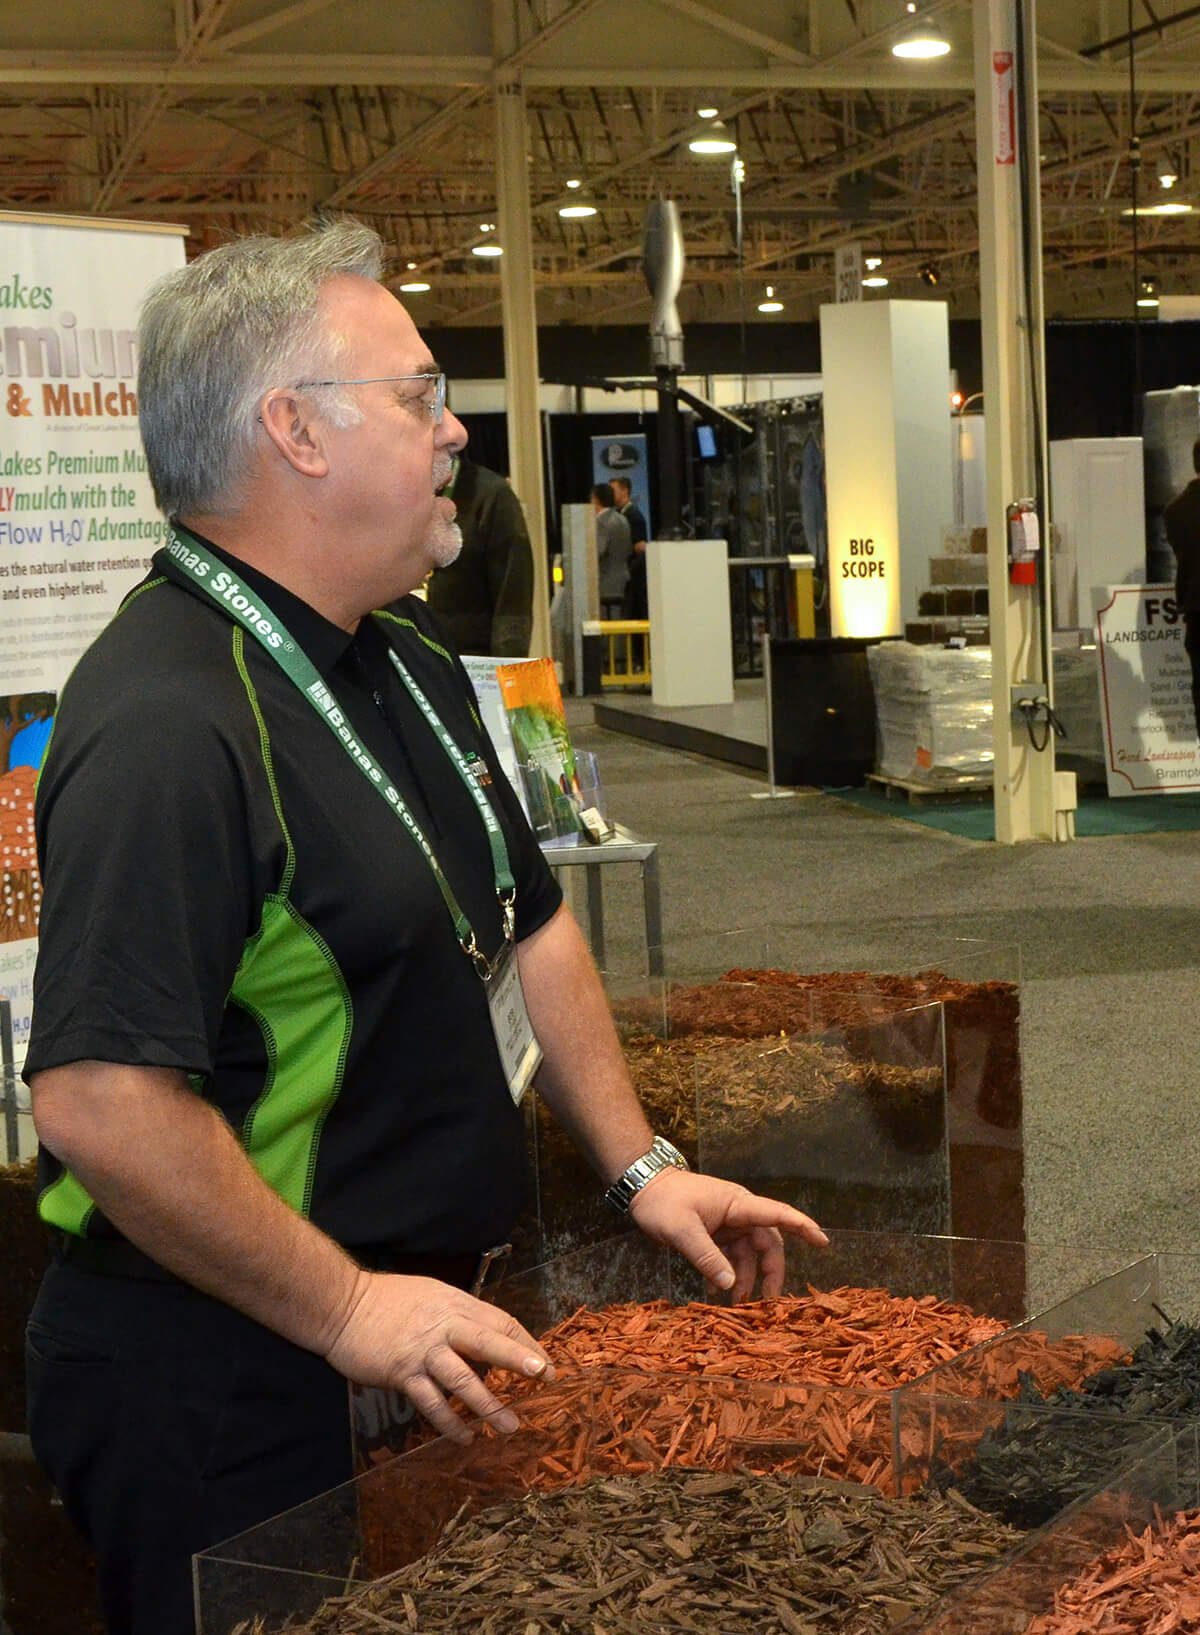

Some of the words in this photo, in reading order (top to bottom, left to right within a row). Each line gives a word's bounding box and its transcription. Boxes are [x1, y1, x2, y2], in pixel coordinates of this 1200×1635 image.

[6, 382, 33, 417] &
[42, 382, 138, 417] Mulch
[47, 450, 119, 474] Premium
[70, 483, 107, 509] with
[111, 483, 136, 507] the
[166, 529, 210, 577] Banas
[849, 538, 875, 556] BIG
[11, 562, 27, 576] the
[30, 560, 67, 575] natural
[69, 559, 96, 573] water
[97, 556, 141, 570] retention
[842, 561, 885, 578] SCOPE
[3, 586, 19, 600] and
[22, 588, 46, 599] even
[50, 583, 80, 600] higher
[1106, 628, 1182, 643] LANDSCAPE
[326, 705, 383, 783] Banas
[384, 786, 438, 870] Stones
